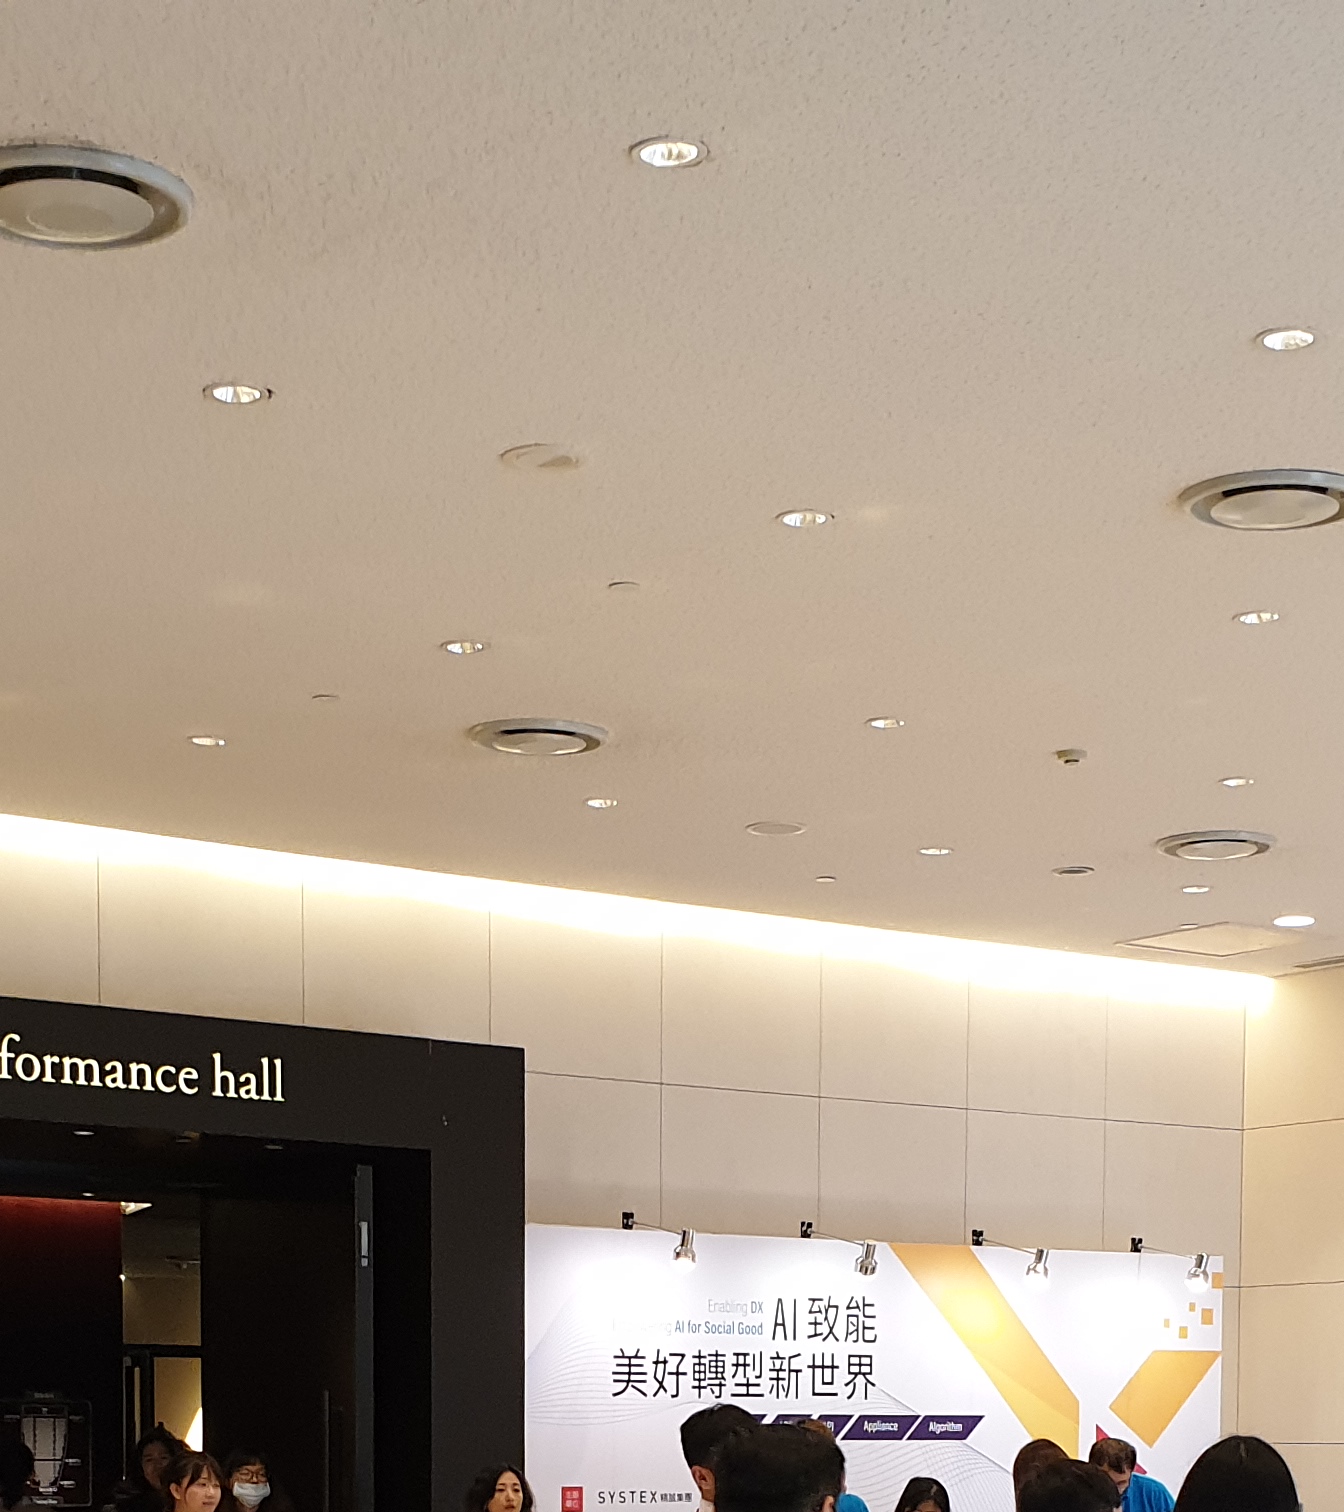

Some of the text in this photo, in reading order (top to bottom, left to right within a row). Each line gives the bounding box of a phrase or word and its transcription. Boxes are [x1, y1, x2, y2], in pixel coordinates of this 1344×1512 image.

[211, 1052, 286, 1102] hall
[707, 1298, 764, 1317] Enabling DX
[674, 1319, 685, 1334] AI
[688, 1319, 702, 1334] for
[704, 1320, 735, 1335] Social
[737, 1321, 763, 1336] Good
[771, 1295, 878, 1344] AI 致能
[611, 1347, 877, 1401] 美好轉型新世界
[863, 1420, 899, 1433] Appliance
[928, 1421, 963, 1434] Algorithm
[597, 1490, 658, 1504] SYSTEX
